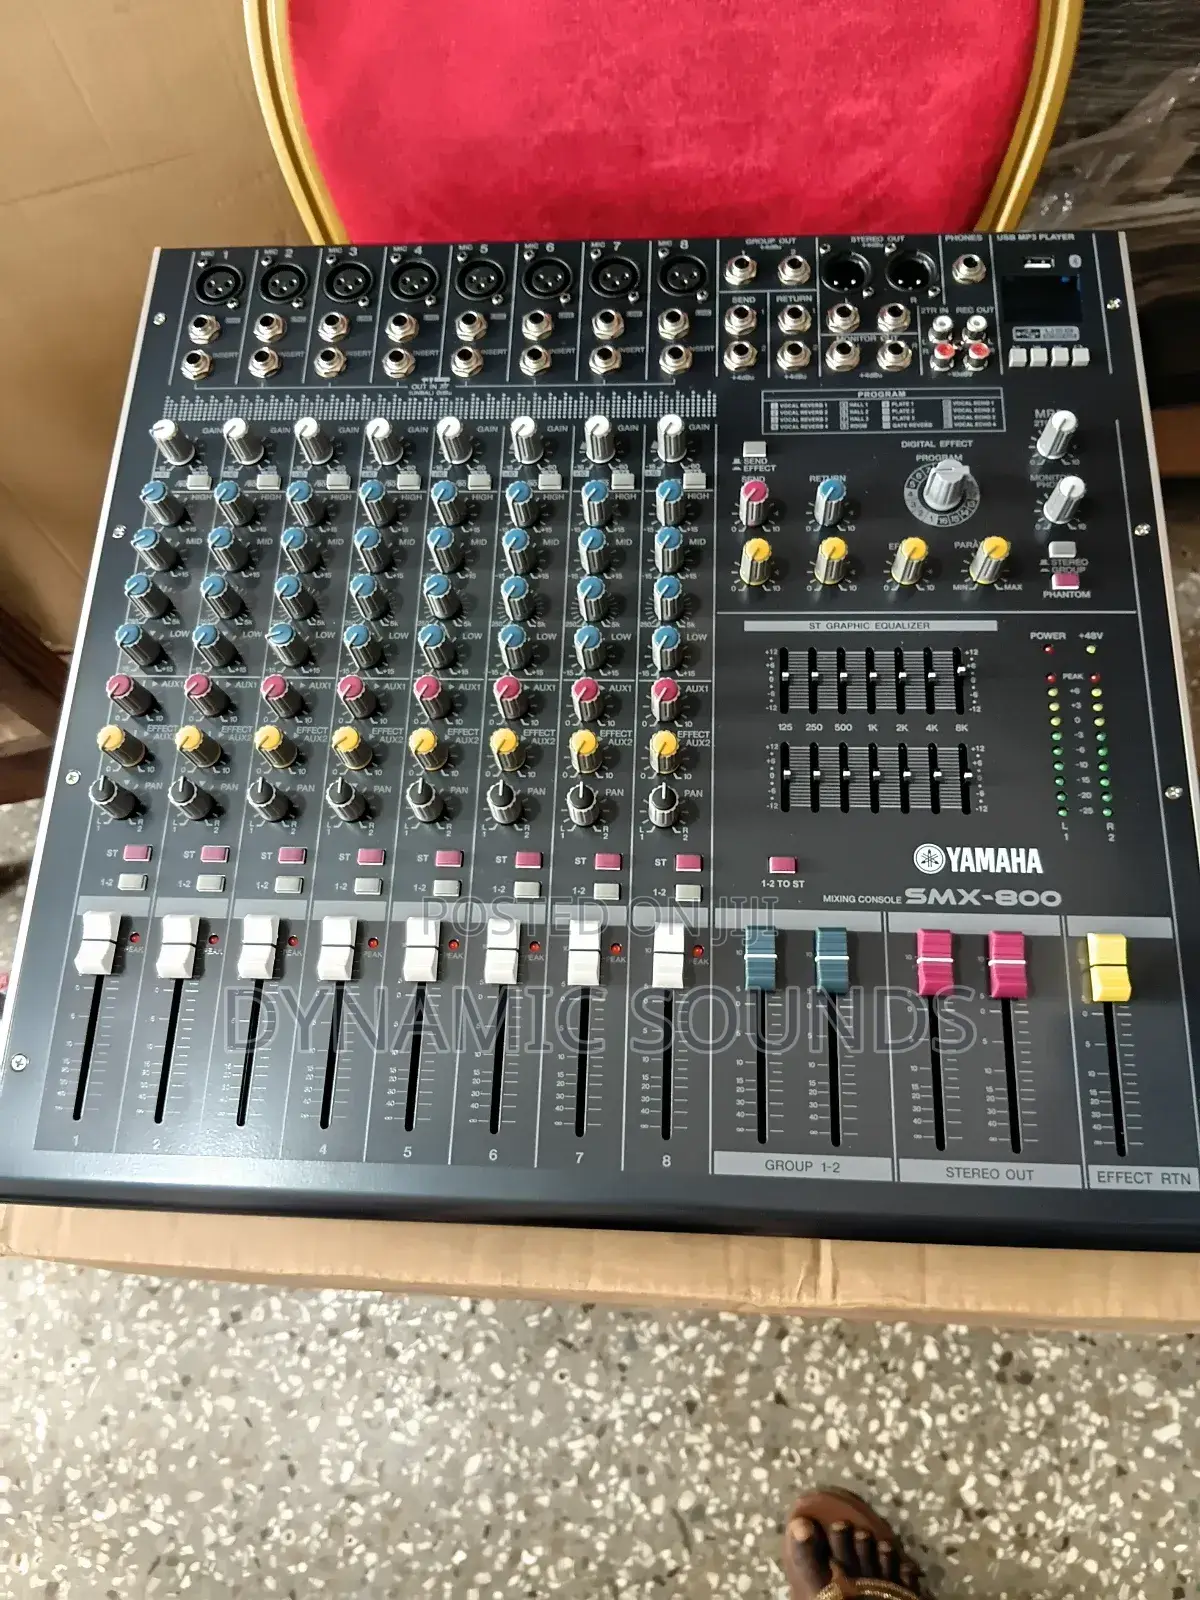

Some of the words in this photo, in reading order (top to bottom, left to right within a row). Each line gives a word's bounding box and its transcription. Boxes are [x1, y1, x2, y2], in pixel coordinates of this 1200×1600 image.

[480, 244, 488, 253] 5
[546, 243, 554, 252] 6
[612, 241, 622, 251] 7
[680, 240, 689, 249] 8
[285, 249, 293, 258] 2
[348, 247, 357, 256] 3
[413, 246, 423, 255] 4
[223, 251, 228, 259] 1
[901, 440, 935, 448] DIGITAL
[940, 440, 973, 448] EFFECT
[542, 493, 565, 501] HIGH
[809, 622, 821, 630] ST
[826, 622, 870, 630] GRAPHIC
[875, 622, 930, 630] EQUALIZER
[316, 631, 336, 639] LOW
[1030, 632, 1066, 640] POWER
[1078, 632, 1104, 640] +48V
[309, 682, 331, 690] AUX1
[458, 683, 481, 691] AUX1
[533, 684, 556, 692] AUX1
[609, 684, 632, 692] AUX1
[685, 685, 709, 693] AUX1
[221, 725, 253, 734] EFFECT
[372, 727, 403, 736] EFFECT
[447, 728, 479, 736] EFFECT
[523, 729, 556, 737] EFFECT
[228, 735, 253, 743] AUX2
[379, 735, 404, 743] AUX2
[455, 737, 479, 745] AUX2
[686, 739, 711, 747] AUX2
[144, 782, 163, 790] PAN
[220, 783, 239, 791] PAN
[373, 785, 392, 793] PAN
[1062, 822, 1068, 830] L
[1107, 822, 1114, 830] R
[1108, 833, 1115, 841] 2
[338, 853, 351, 861] ST
[946, 846, 1043, 874] YAMAHA
[654, 858, 667, 866] ST
[334, 883, 348, 891] 1-2
[761, 880, 775, 888] 1-2
[778, 880, 791, 888] TO
[793, 880, 805, 888] ST
[653, 888, 666, 896] 1-2
[823, 894, 856, 904] MIXING
[858, 894, 902, 904] CONSOLE
[905, 888, 1062, 907] SMX-800
[73, 1134, 79, 1147] 1
[152, 1138, 161, 1151] 2
[319, 1143, 327, 1155] 4
[403, 1146, 412, 1158] 5
[489, 1149, 498, 1161] 6
[575, 1152, 584, 1164] 7
[662, 1154, 671, 1168] 8
[764, 1160, 814, 1174] GROUP
[821, 1161, 840, 1174] 1-2
[945, 1166, 1001, 1180] STEREO
[1004, 1167, 1034, 1182] OUT
[1097, 1171, 1152, 1184] EFFECT
[1161, 1173, 1191, 1185] RTN
